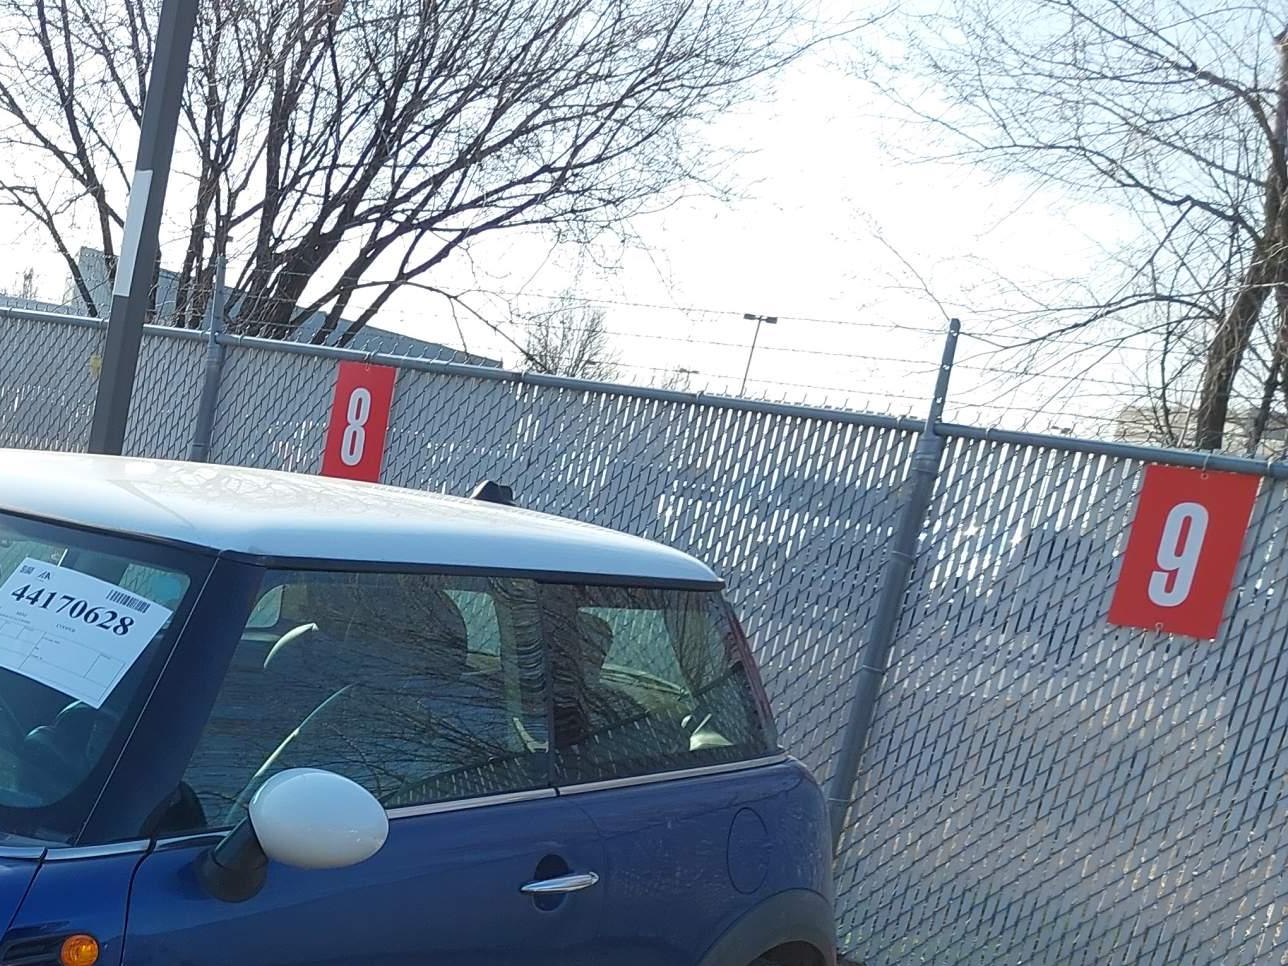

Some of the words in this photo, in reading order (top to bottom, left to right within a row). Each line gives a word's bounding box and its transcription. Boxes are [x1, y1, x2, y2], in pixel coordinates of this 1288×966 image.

[340, 387, 371, 466] 8
[1147, 502, 1209, 607] 9
[10, 583, 135, 636] 44170628
